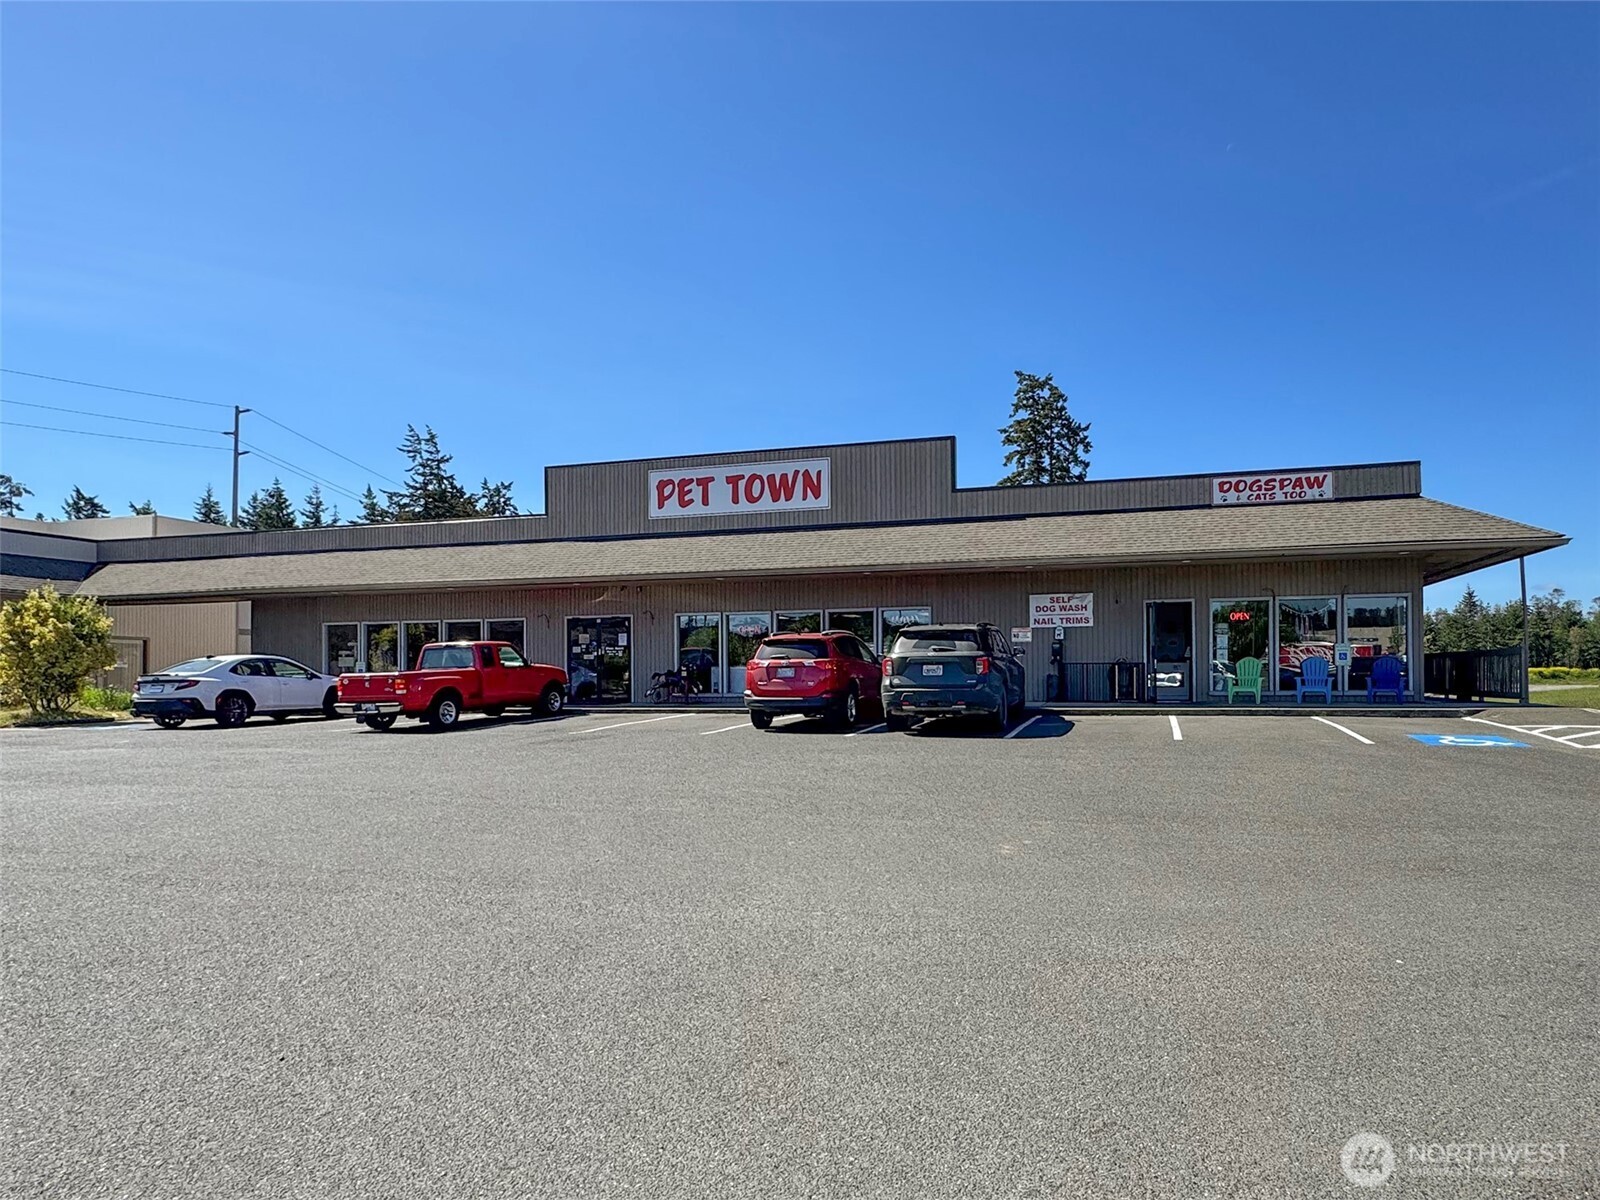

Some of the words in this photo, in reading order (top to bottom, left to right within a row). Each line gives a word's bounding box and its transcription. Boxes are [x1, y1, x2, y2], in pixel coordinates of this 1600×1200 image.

[1218, 474, 1328, 494] DOGSPAW
[656, 476, 715, 510] PET
[725, 469, 822, 505] TOWN
[1247, 492, 1277, 502] CATS
[1282, 490, 1307, 500] TOO
[1049, 596, 1073, 604] SELF
[1035, 605, 1056, 613] DOG
[1059, 604, 1088, 612] WASH
[1033, 617, 1057, 625] NAIL
[1059, 616, 1090, 625] TRIMS
[1229, 611, 1250, 621] OPEN
